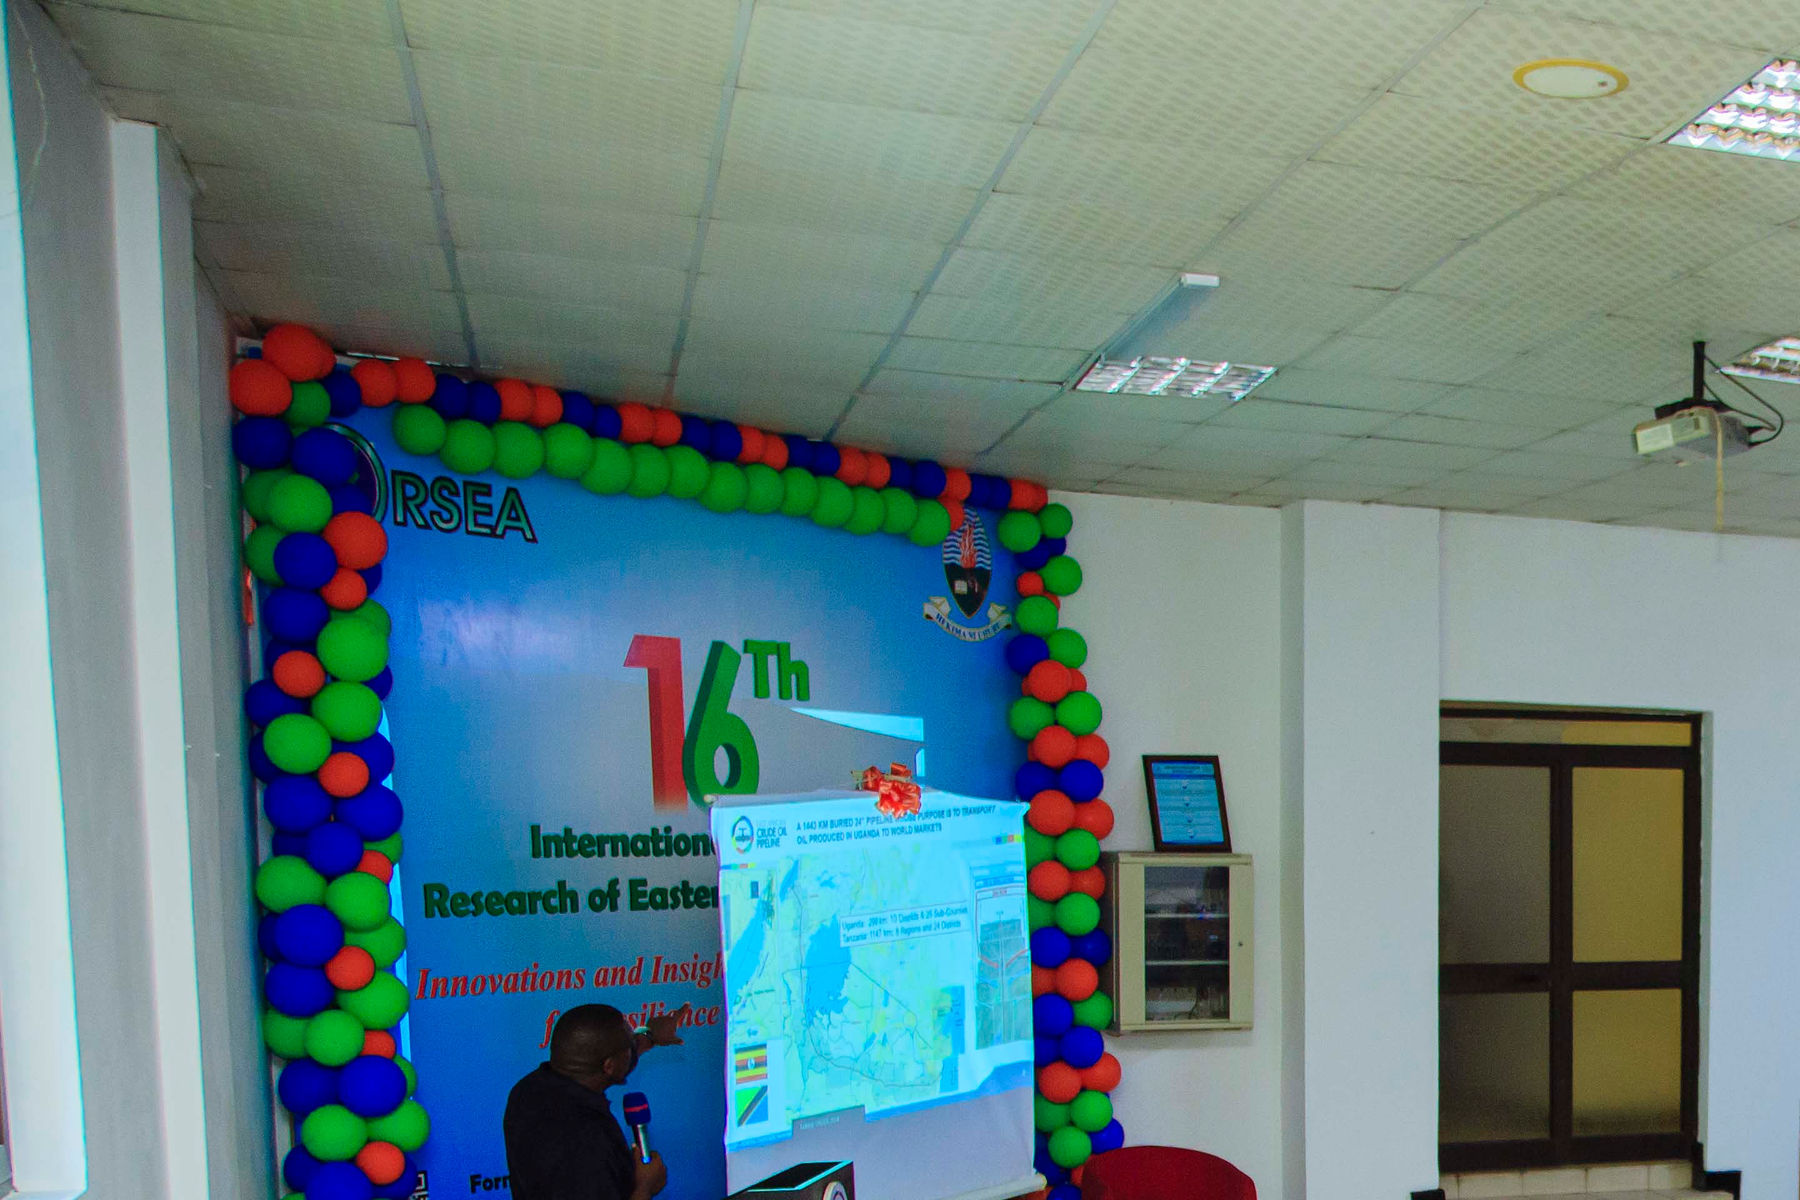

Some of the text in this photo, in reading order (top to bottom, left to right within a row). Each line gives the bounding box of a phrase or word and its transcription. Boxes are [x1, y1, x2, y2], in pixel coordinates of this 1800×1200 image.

[423, 883, 580, 918] Research
[587, 877, 621, 913] of
[415, 961, 587, 1000] Innovations
[593, 956, 644, 988] and
